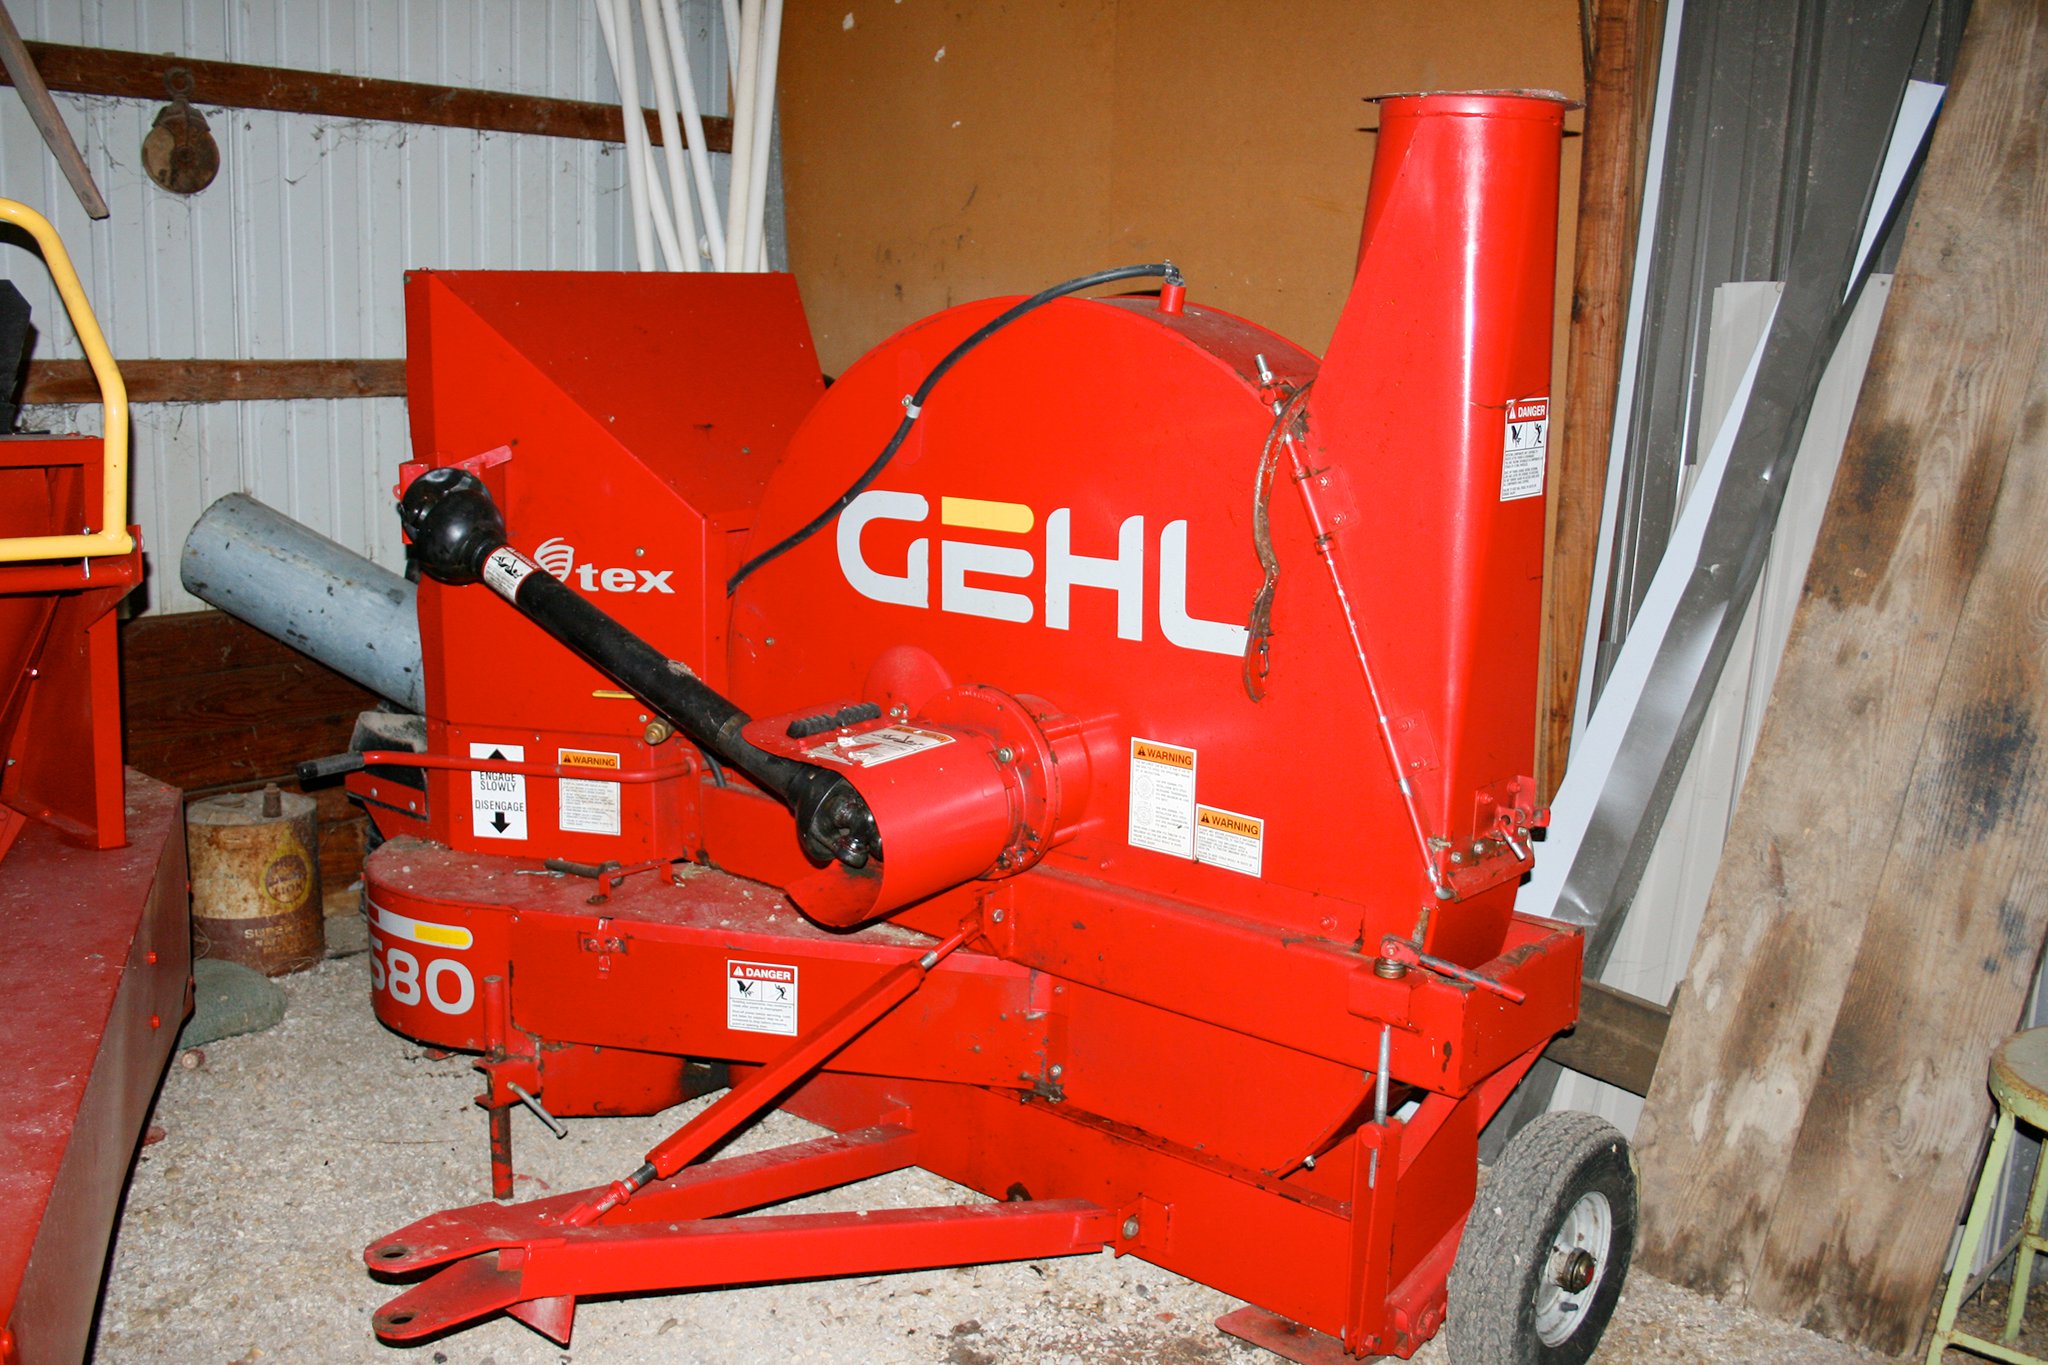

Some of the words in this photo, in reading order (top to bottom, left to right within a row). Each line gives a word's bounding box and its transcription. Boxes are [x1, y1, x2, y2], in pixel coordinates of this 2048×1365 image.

[1517, 405, 1546, 418] DANGER
[575, 563, 675, 594] tex
[836, 490, 1250, 657] GEHL
[573, 755, 616, 767] WARNING
[1146, 748, 1192, 766] WARNING
[480, 771, 516, 782] ENGAGE
[480, 781, 517, 792] SLOWLY
[474, 800, 524, 812] DISENGAGE
[1211, 815, 1259, 835] WARNING
[369, 935, 475, 1015] 580
[745, 967, 791, 981] DANGER
